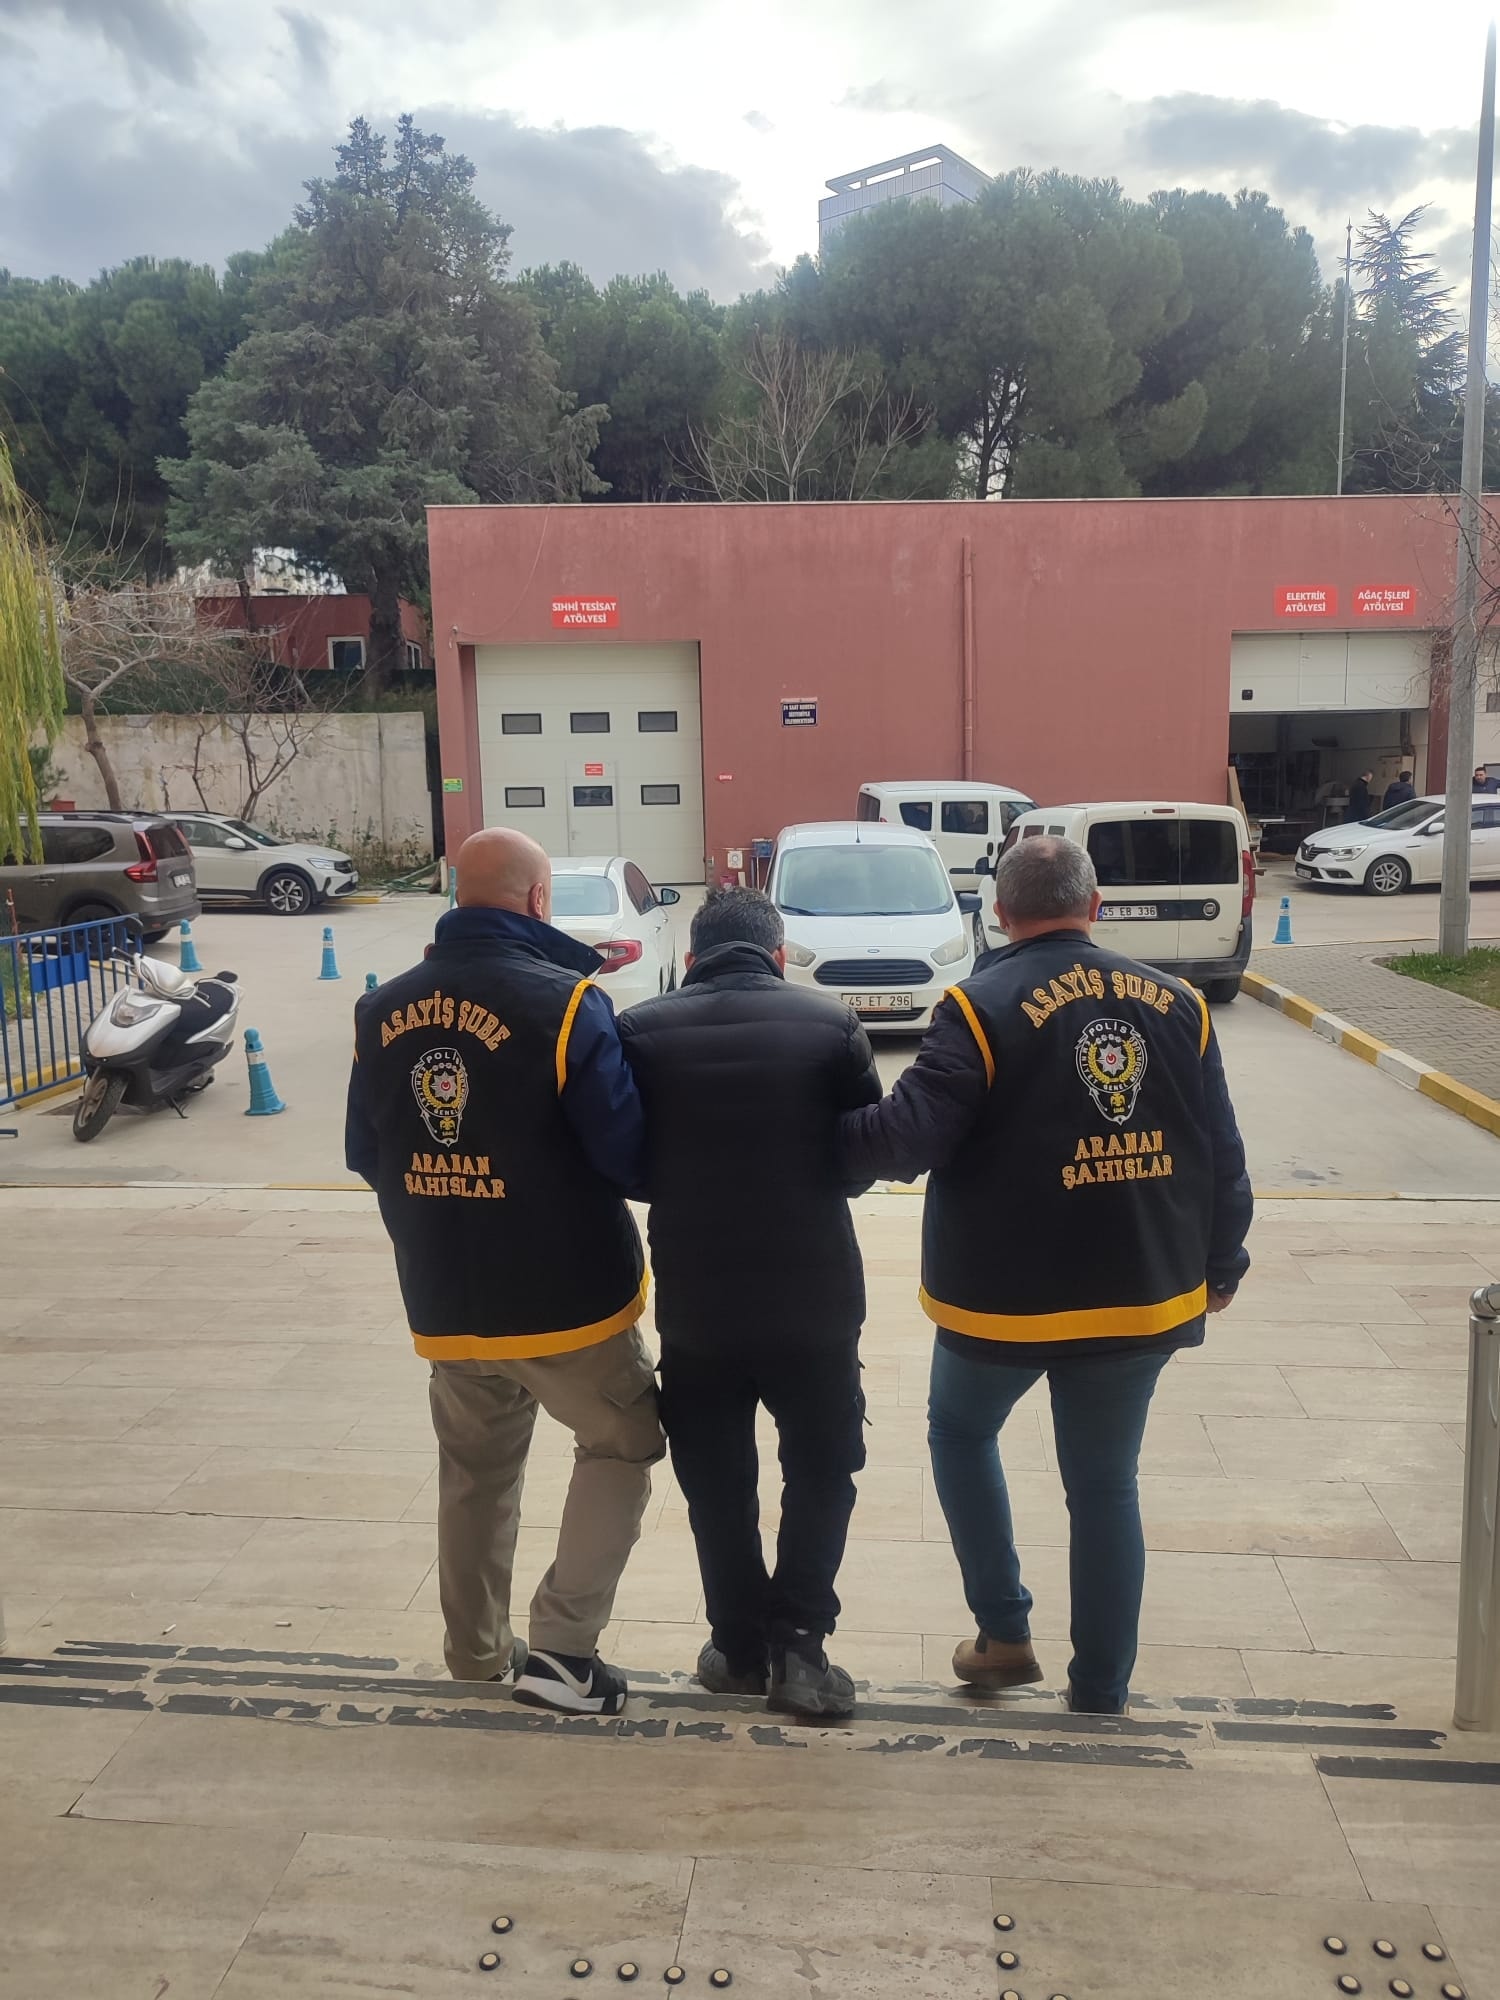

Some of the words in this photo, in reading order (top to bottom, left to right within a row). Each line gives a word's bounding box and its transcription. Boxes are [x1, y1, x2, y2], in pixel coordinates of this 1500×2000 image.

[1286, 590, 1326, 601] ELEKTRİK
[1358, 590, 1382, 601] AĞAÇ
[1384, 590, 1410, 601] İŞLERİ
[580, 601, 617, 611] TESİSAT
[1285, 602, 1326, 612] ATÖLYESİ
[1363, 601, 1404, 611] ATÖLYESİ
[563, 613, 607, 623] ATÖLYESİ
[1103, 907, 1114, 916] 45
[1120, 907, 1132, 916] EB
[1138, 906, 1157, 916] 336
[848, 996, 862, 1007] 45
[869, 996, 883, 1007] ET
[889, 995, 910, 1006] 296
[1020, 963, 1104, 1029] ASAYİŞ
[1111, 970, 1175, 1015] ŞUBE
[381, 990, 455, 1048] ASAYİŞ
[458, 1000, 511, 1051] ŞUBE
[1088, 1021, 1128, 1037] POLİS
[1074, 1130, 1163, 1161] ARANAN
[1061, 1154, 1173, 1190] ŞAHISLAR
[404, 1172, 506, 1198] ŞAHISLAR
